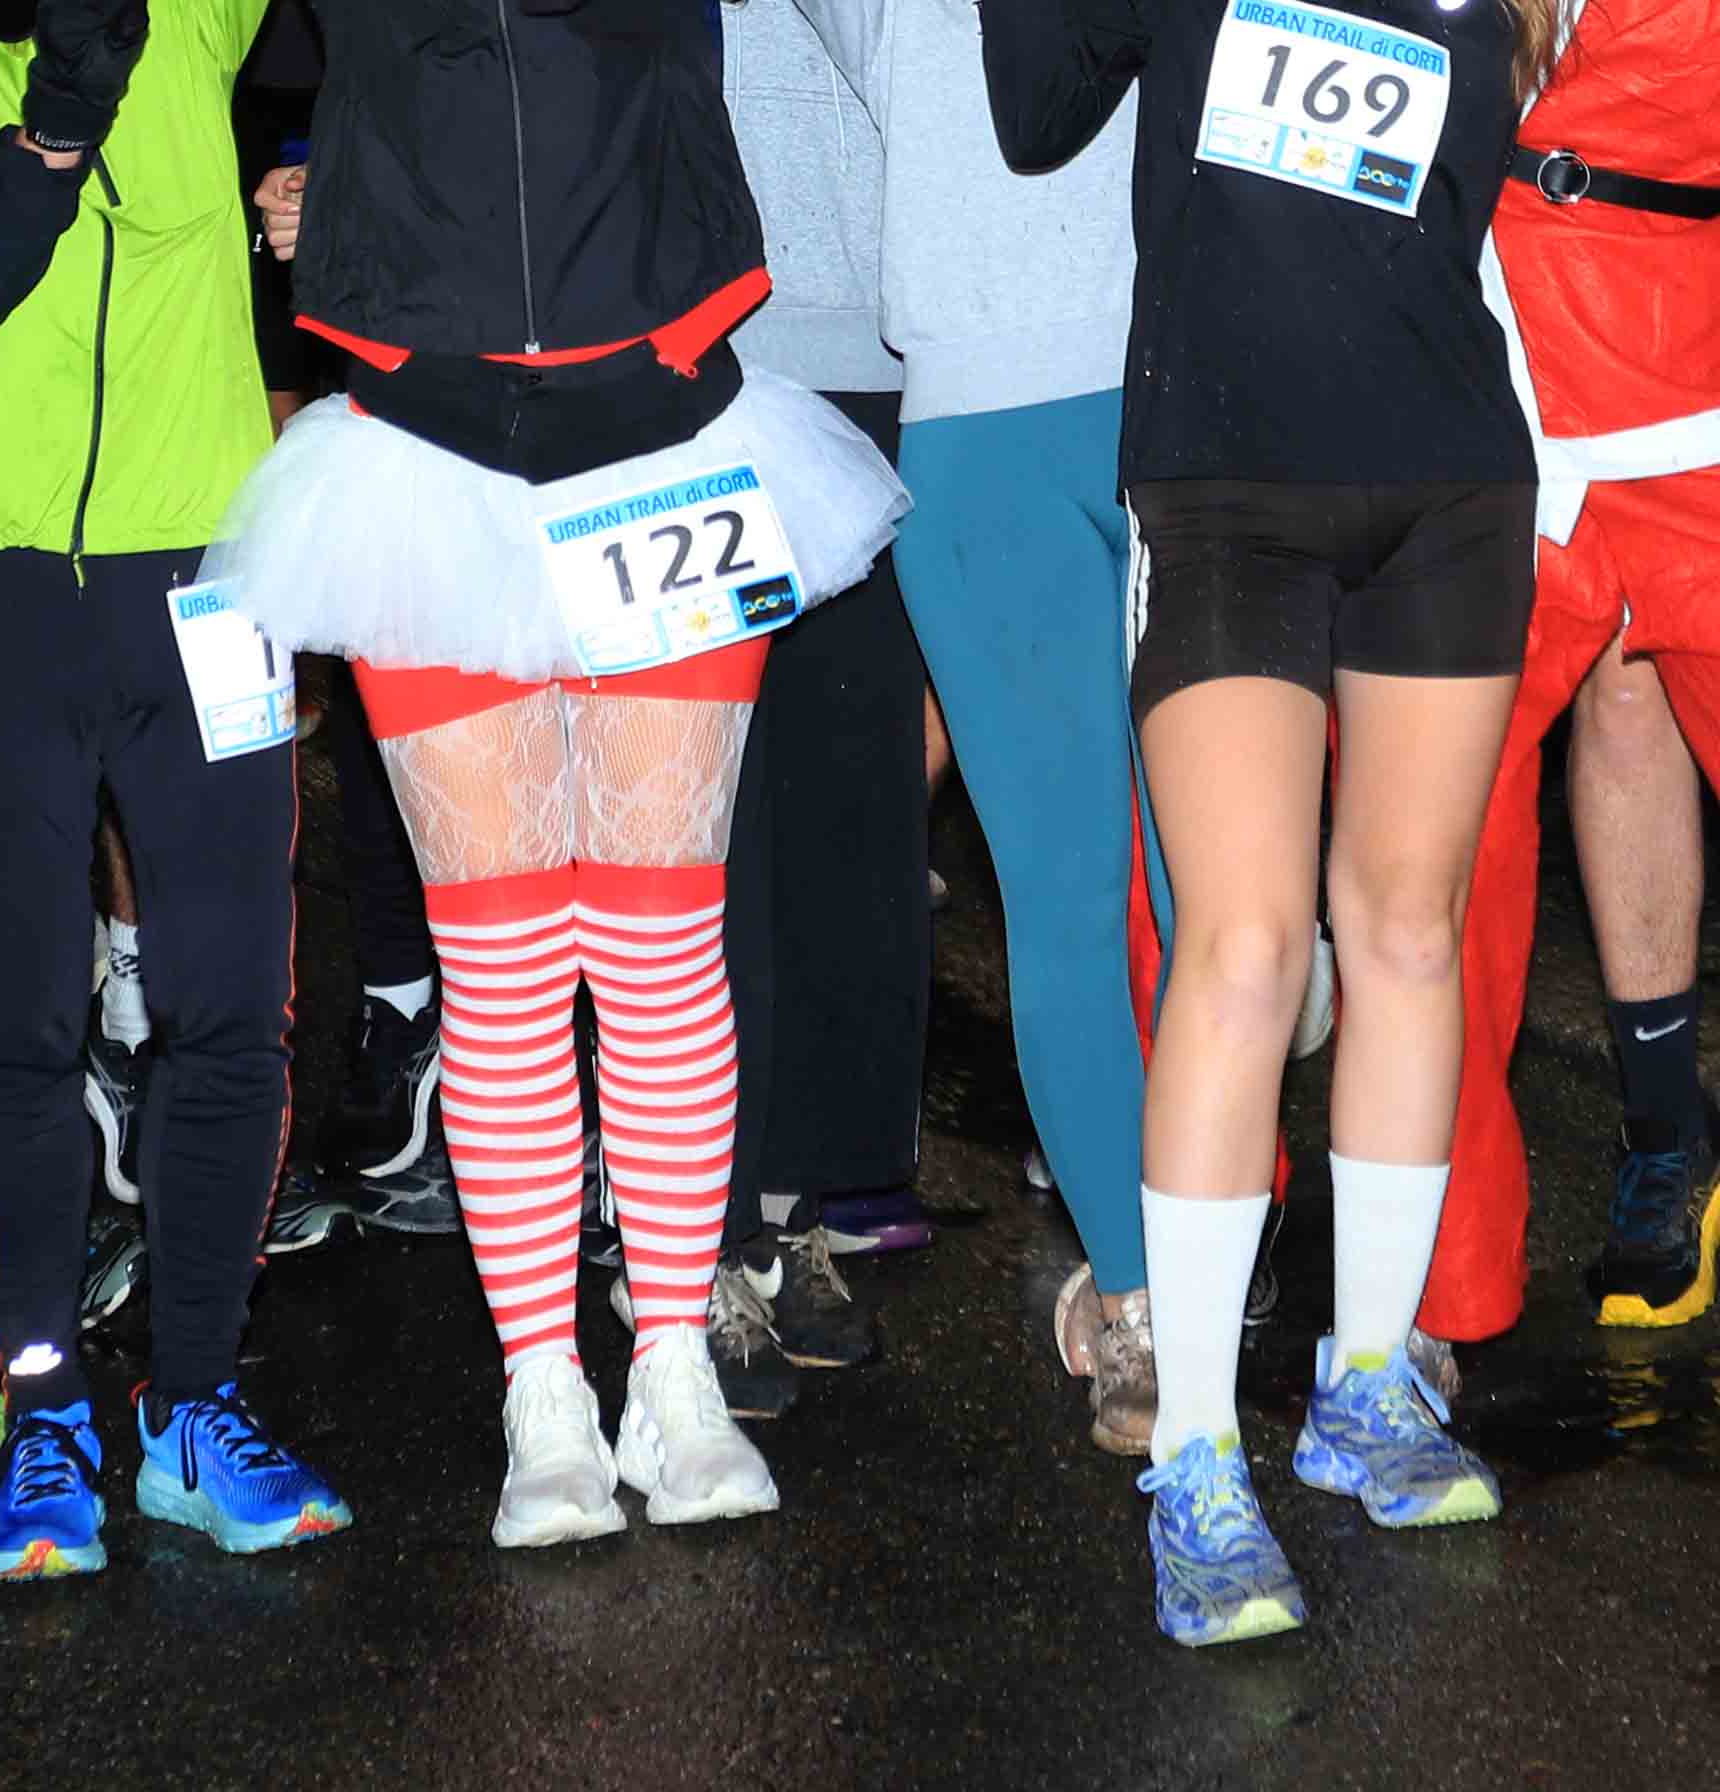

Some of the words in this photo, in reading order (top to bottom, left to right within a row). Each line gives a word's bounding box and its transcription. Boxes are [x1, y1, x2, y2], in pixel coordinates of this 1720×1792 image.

[1236, 0, 1307, 34] URBAN
[1312, 20, 1365, 51] TRAIL
[1371, 38, 1389, 56] di
[1261, 44, 1410, 138] 169
[548, 510, 623, 545] URBAN
[626, 492, 682, 523] TRAIL
[685, 487, 704, 506] di
[602, 510, 756, 606] 122
